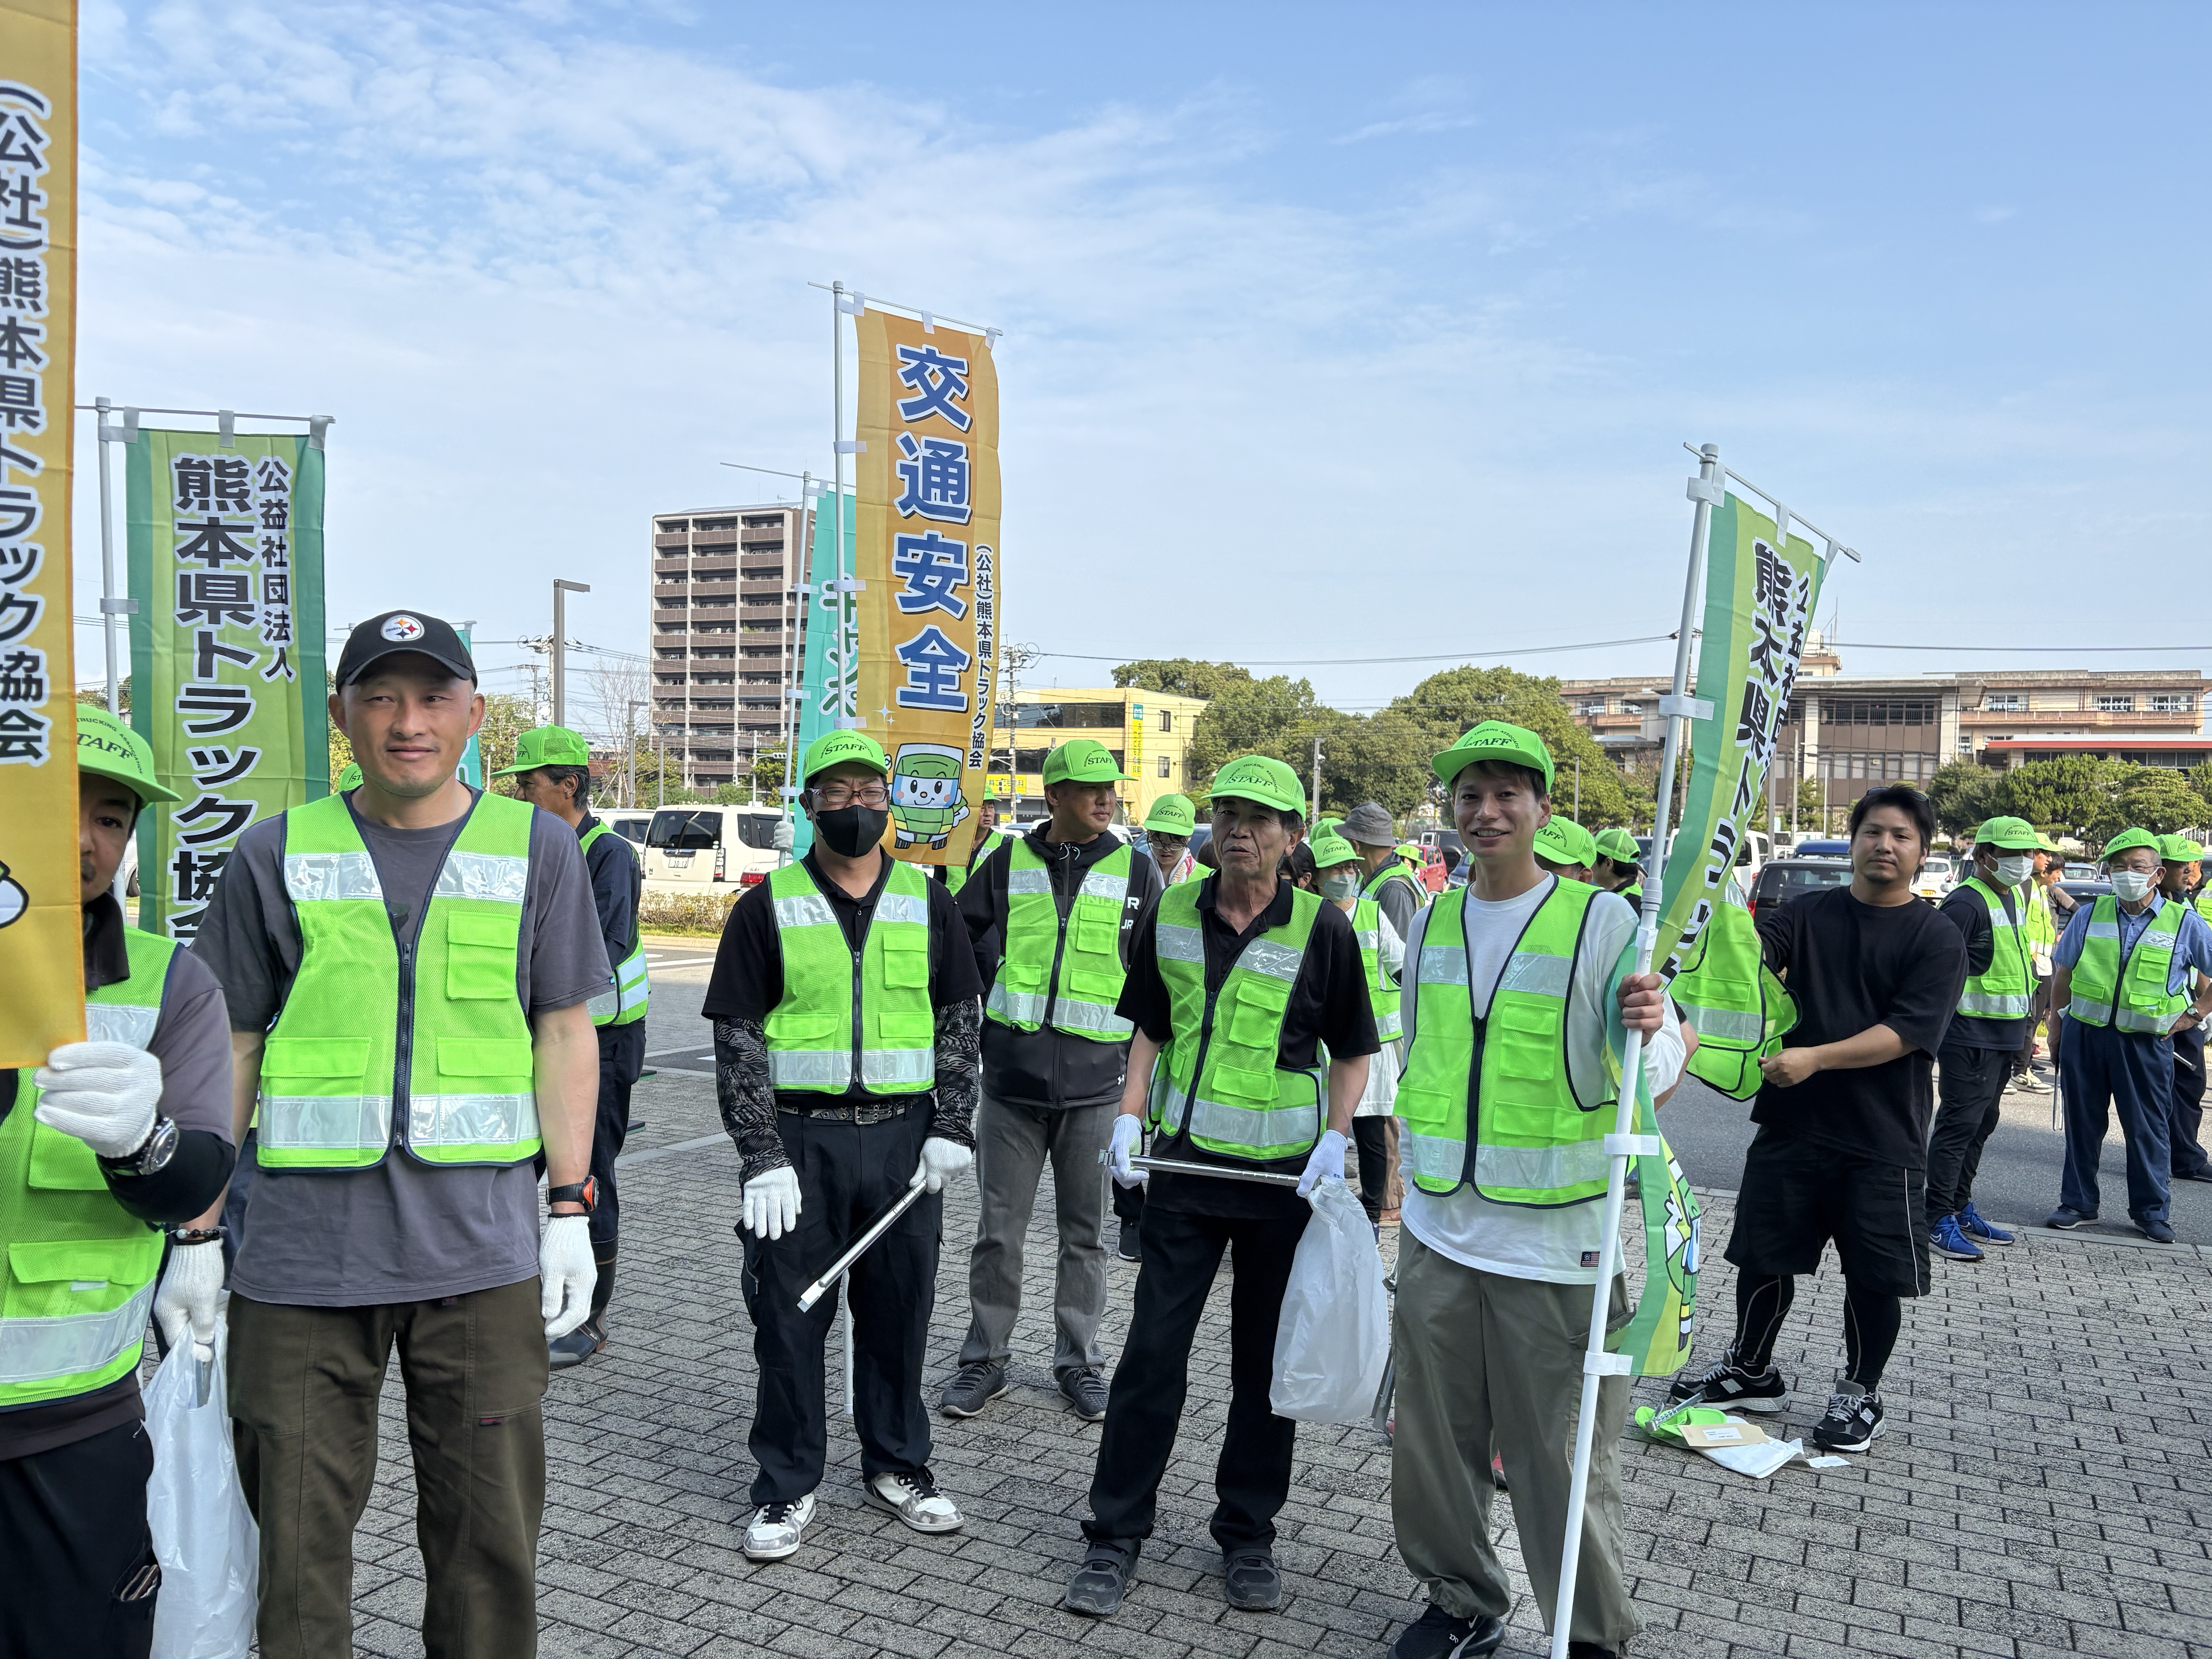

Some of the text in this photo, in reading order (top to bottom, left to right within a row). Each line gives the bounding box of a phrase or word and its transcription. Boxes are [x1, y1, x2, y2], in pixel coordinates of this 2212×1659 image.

[894, 345, 970, 711] 交通安全
[256, 460, 293, 679] 公益社団法人
[77, 733, 133, 759] TAFF
[825, 744, 867, 755] STAFF
[1229, 776, 1273, 787] STAFF
[1537, 829, 1563, 840] AFF
